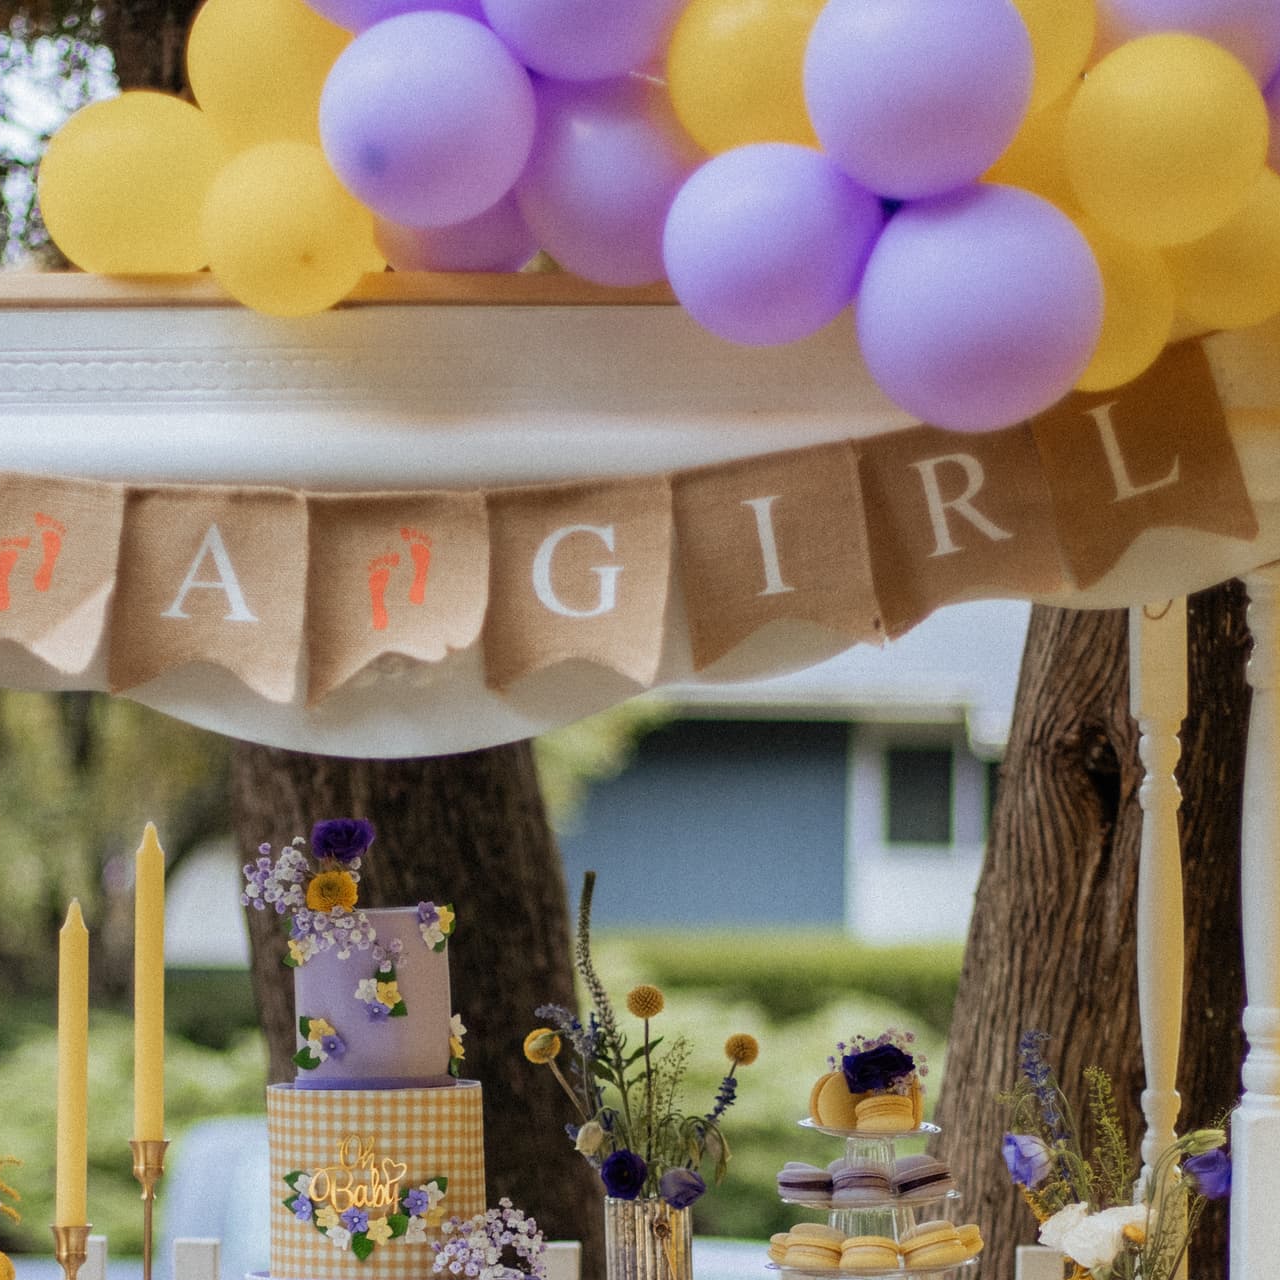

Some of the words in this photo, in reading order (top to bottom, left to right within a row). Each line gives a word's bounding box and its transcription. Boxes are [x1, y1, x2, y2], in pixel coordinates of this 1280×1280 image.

[160, 523, 260, 622] A
[531, 402, 1181, 619] GIRL
[336, 1135, 376, 1170] Oh
[308, 1158, 407, 1215] Baby
